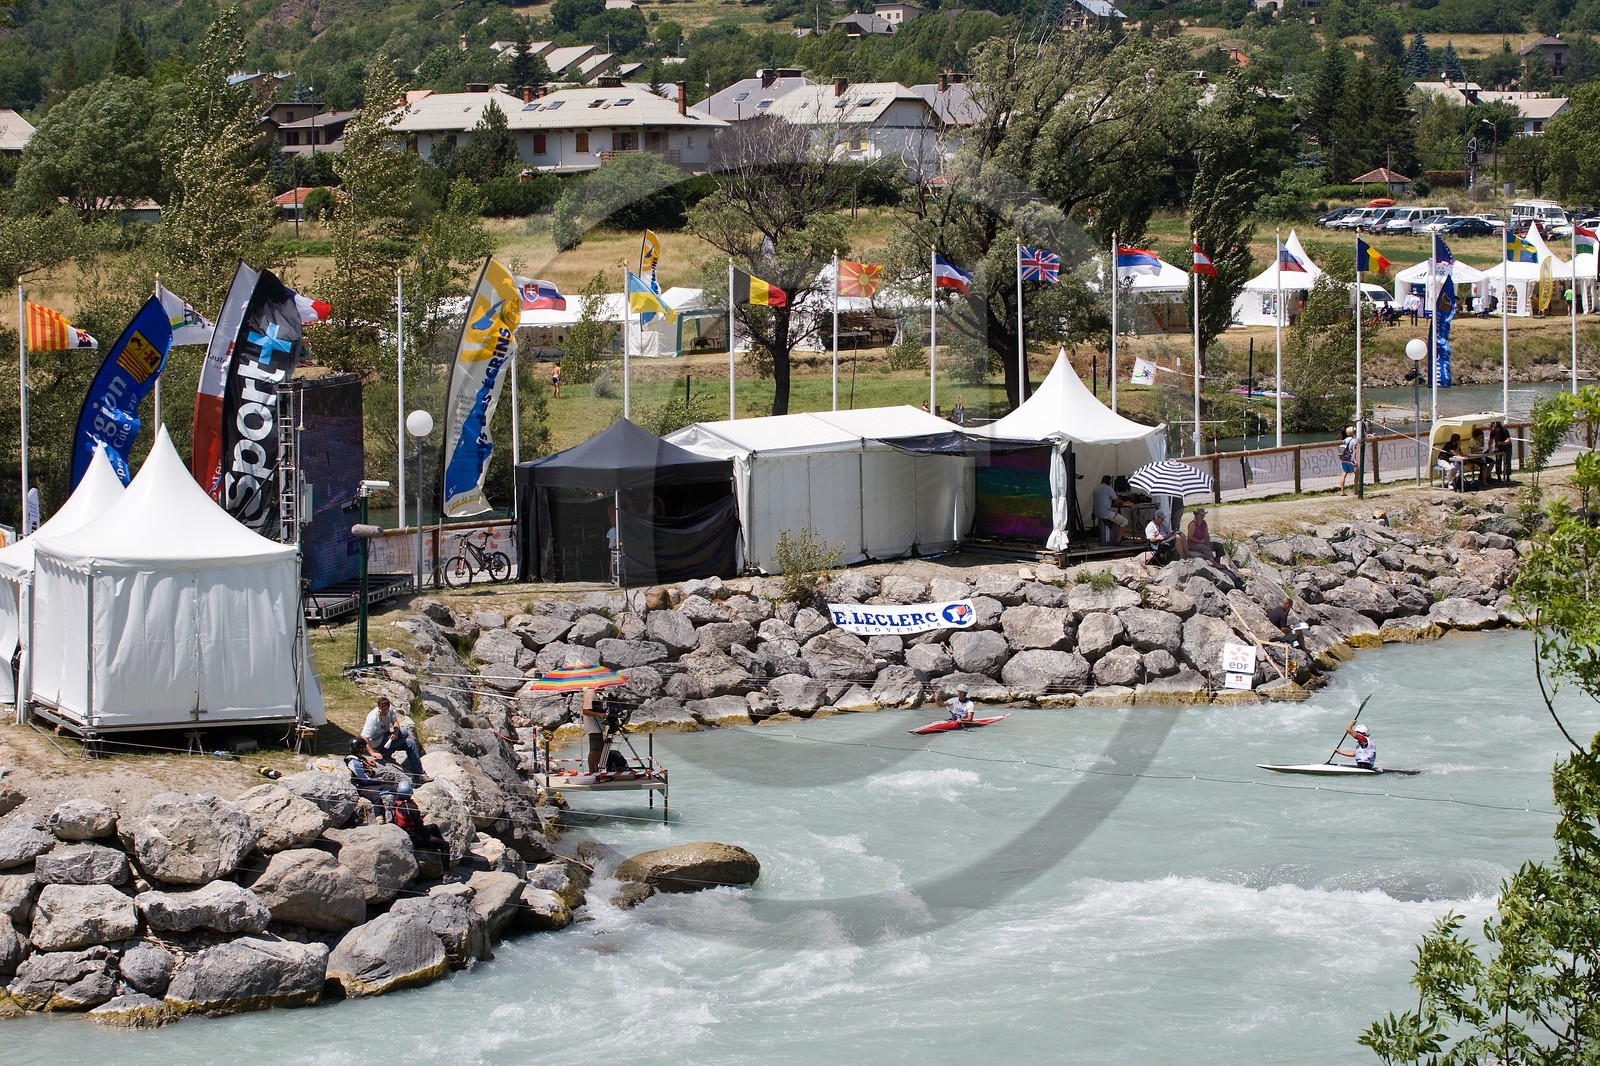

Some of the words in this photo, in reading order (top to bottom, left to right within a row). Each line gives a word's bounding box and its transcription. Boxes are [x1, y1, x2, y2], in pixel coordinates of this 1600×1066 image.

[92, 375, 127, 452] gion
[114, 423, 131, 448] Côte
[833, 611, 938, 627] E.LECLERC
